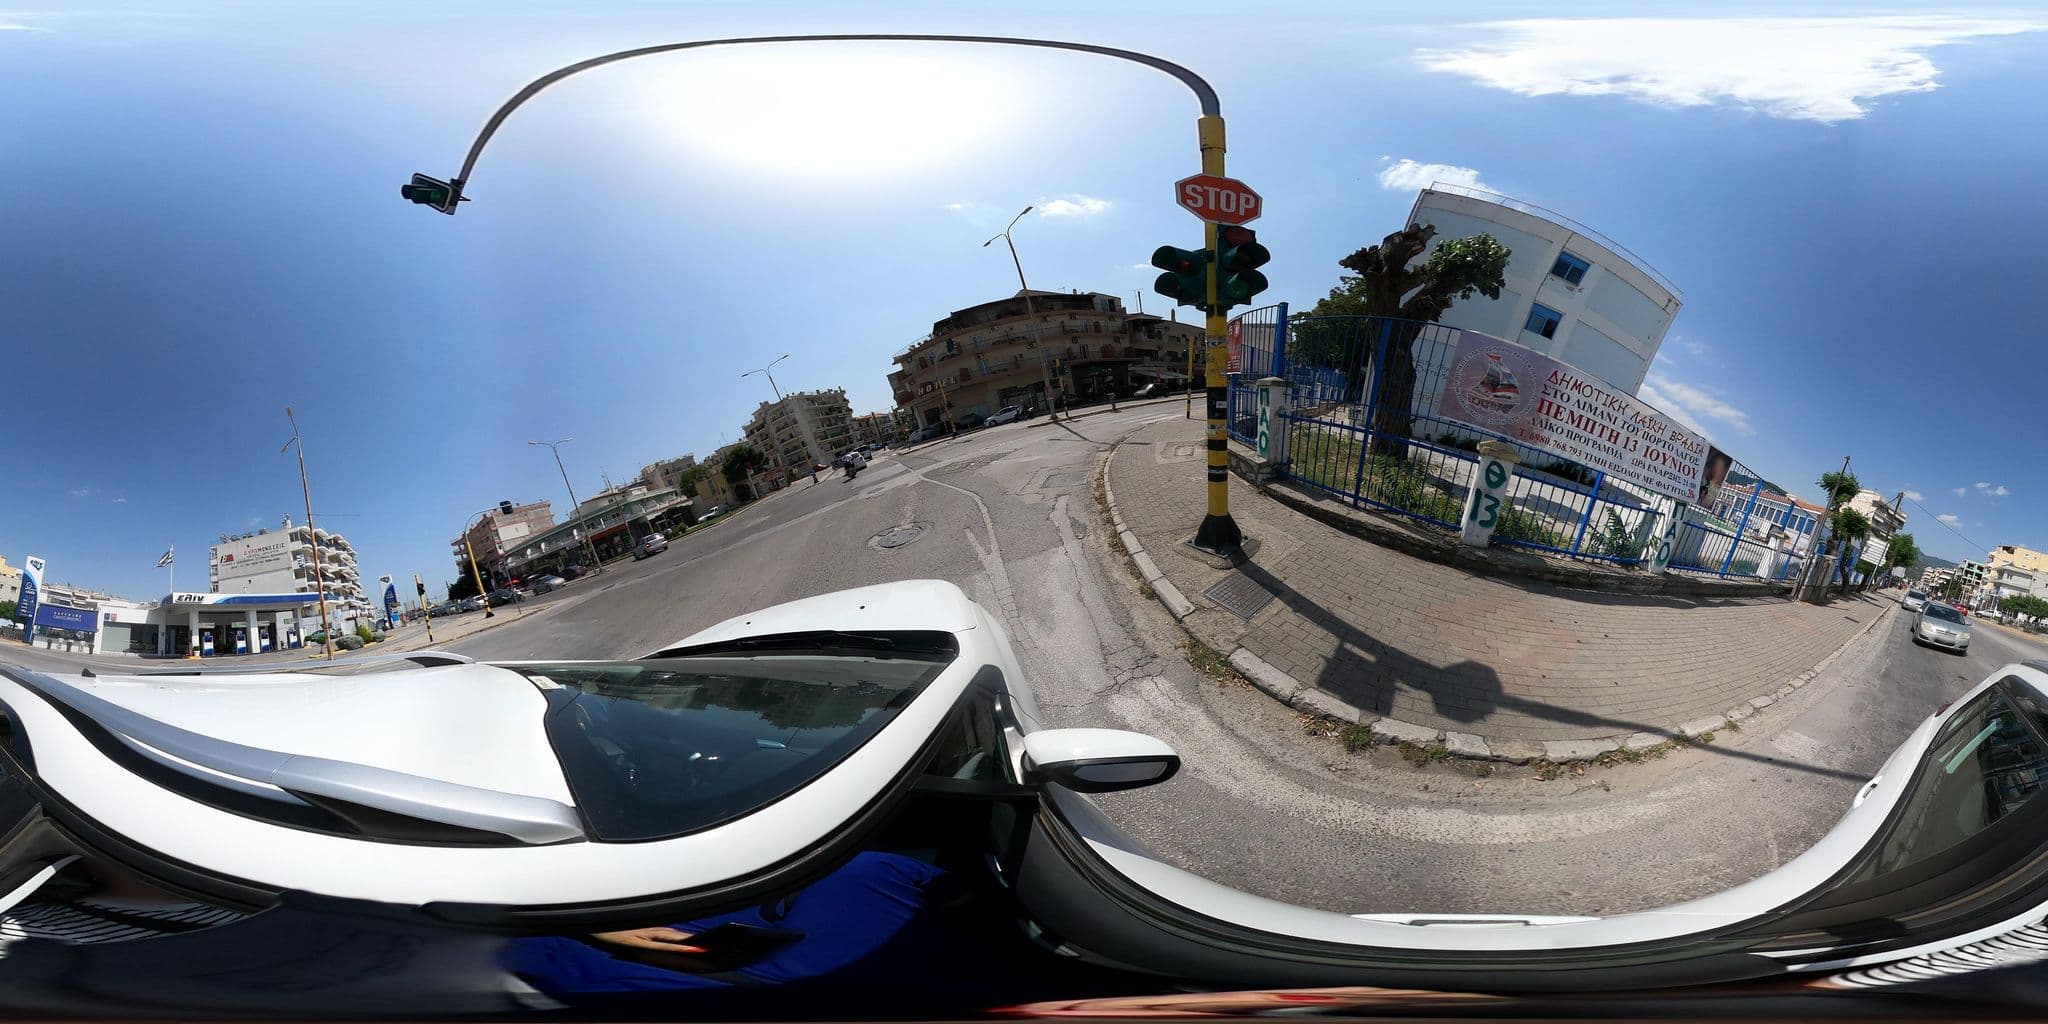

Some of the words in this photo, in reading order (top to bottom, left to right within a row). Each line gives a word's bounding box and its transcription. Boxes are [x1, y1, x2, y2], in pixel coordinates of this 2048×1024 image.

[1185, 184, 1255, 217] STOP
[1258, 386, 1271, 458] ΠΑΟ
[1537, 397, 1621, 445] ΠΕΜΠΤΗ
[1622, 436, 1638, 453] 13
[1642, 445, 1700, 480] ΙΟΥΝΙΟΥ
[1542, 383, 1571, 403] ΣΤΟ
[1572, 399, 1618, 425] ΛΙΜΑΝΙ
[1621, 419, 1642, 435] ΤΟΥ
[1641, 430, 1674, 452] ΠΟΡΤΟ
[1673, 447, 1700, 466] ΛΑΓΟΣ
[1547, 369, 1630, 416] ΔΗΜΟΤΙΚΗ
[1669, 430, 1705, 457] ΒΡΑΔΙΑ
[1484, 460, 1507, 490] Θ
[1565, 430, 1623, 460] ΠΡΟΓΡΑΜΜΑ
[1631, 458, 1647, 470] ΩΡΑ
[1647, 463, 1683, 483] ΕΝΑΡΞΗΣ
[1584, 452, 1607, 466] ΤΙΜΗ
[1469, 488, 1502, 529] 13
[1655, 501, 1687, 568] ΠΑΟ
